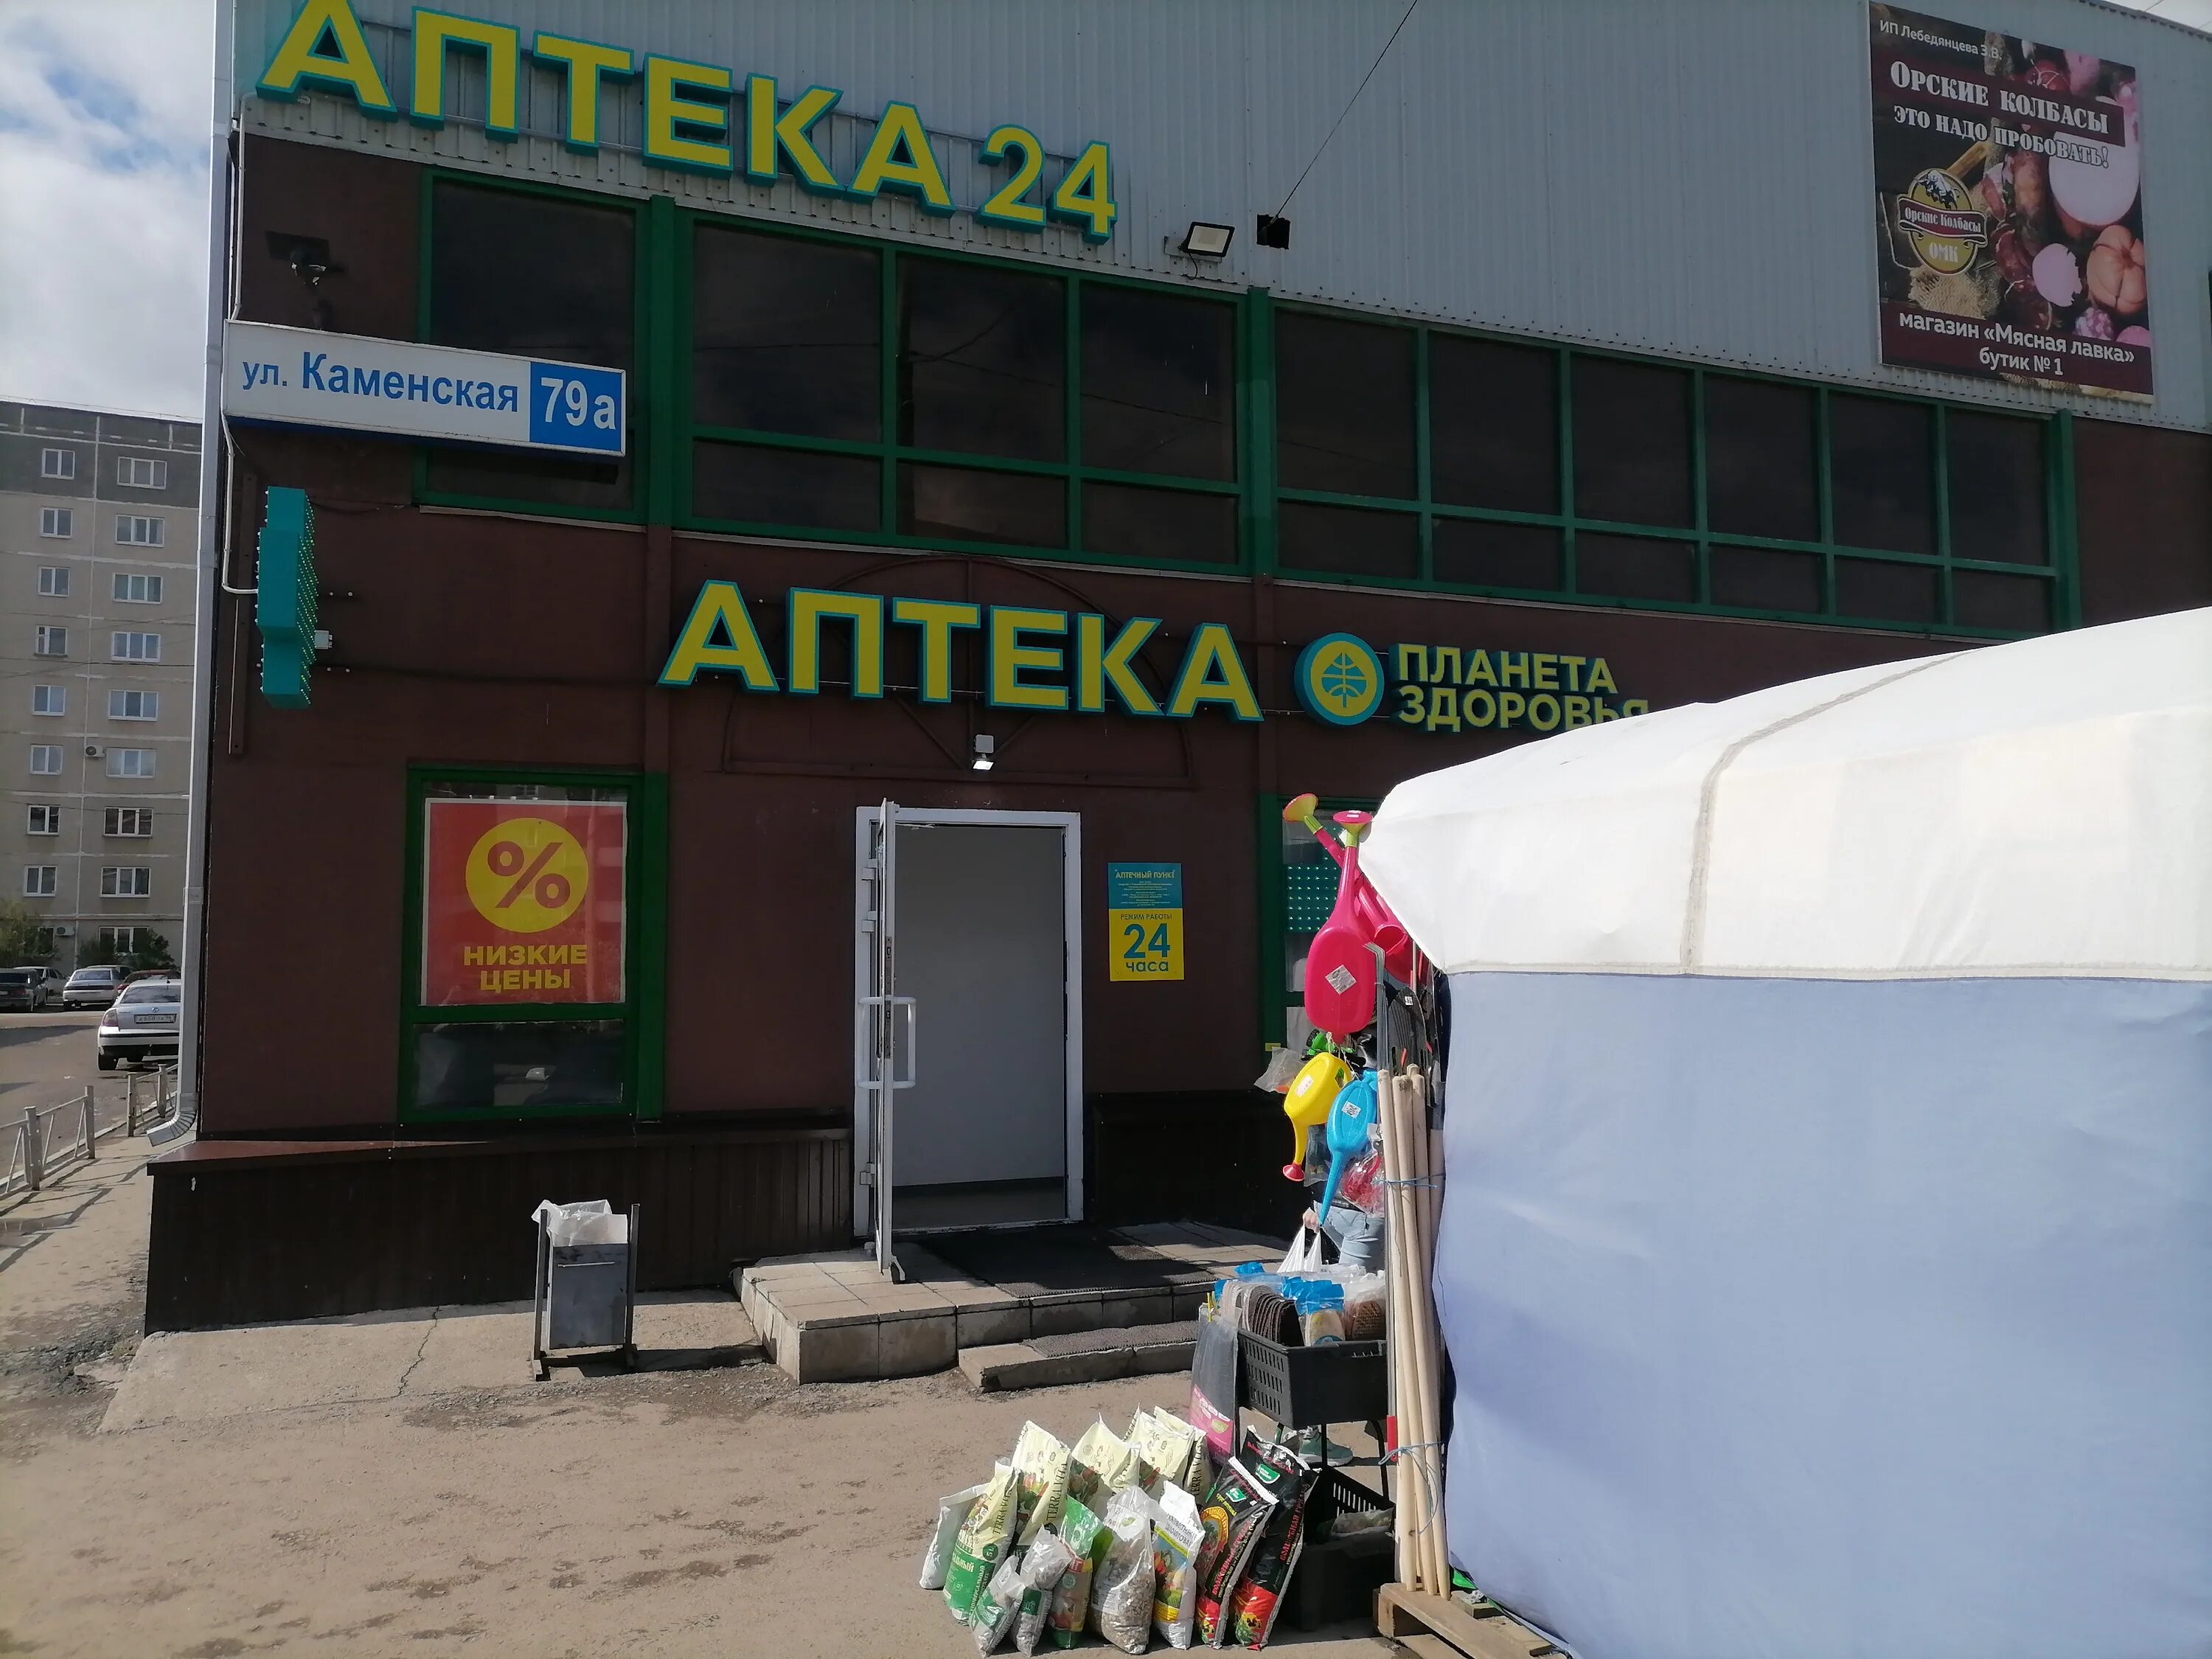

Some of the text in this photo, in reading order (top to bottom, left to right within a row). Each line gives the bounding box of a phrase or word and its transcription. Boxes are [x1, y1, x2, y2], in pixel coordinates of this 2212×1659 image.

[1880, 20, 1898, 35] ИП
[1902, 25, 1978, 55] Лебедянцева
[1890, 60, 2109, 135] ОРСКИЕ КОЛБАСЫ
[255, 0, 1118, 246] АПТЕКА 24
[1894, 105, 2109, 169] ЭТО НАДО ПРОБОВАТЬ!
[1905, 206, 1981, 233] Орские Колбасы
[1929, 242, 1958, 263] ОМК
[1899, 312, 2135, 364] магазин «Мясная лавка»
[1979, 347, 2063, 376] бутик № 1
[242, 351, 616, 430] ул. Каменская 79а
[655, 580, 1265, 722] АПТЕКА
[1395, 643, 1618, 695] ПЛАНЕТА
[464, 945, 588, 966] НИЗКИЕ
[1124, 923, 1171, 959] 24
[480, 969, 571, 993] ЦЕНЫ
[1126, 961, 1169, 972] часа
[1046, 1486, 1062, 1521] TERRA
